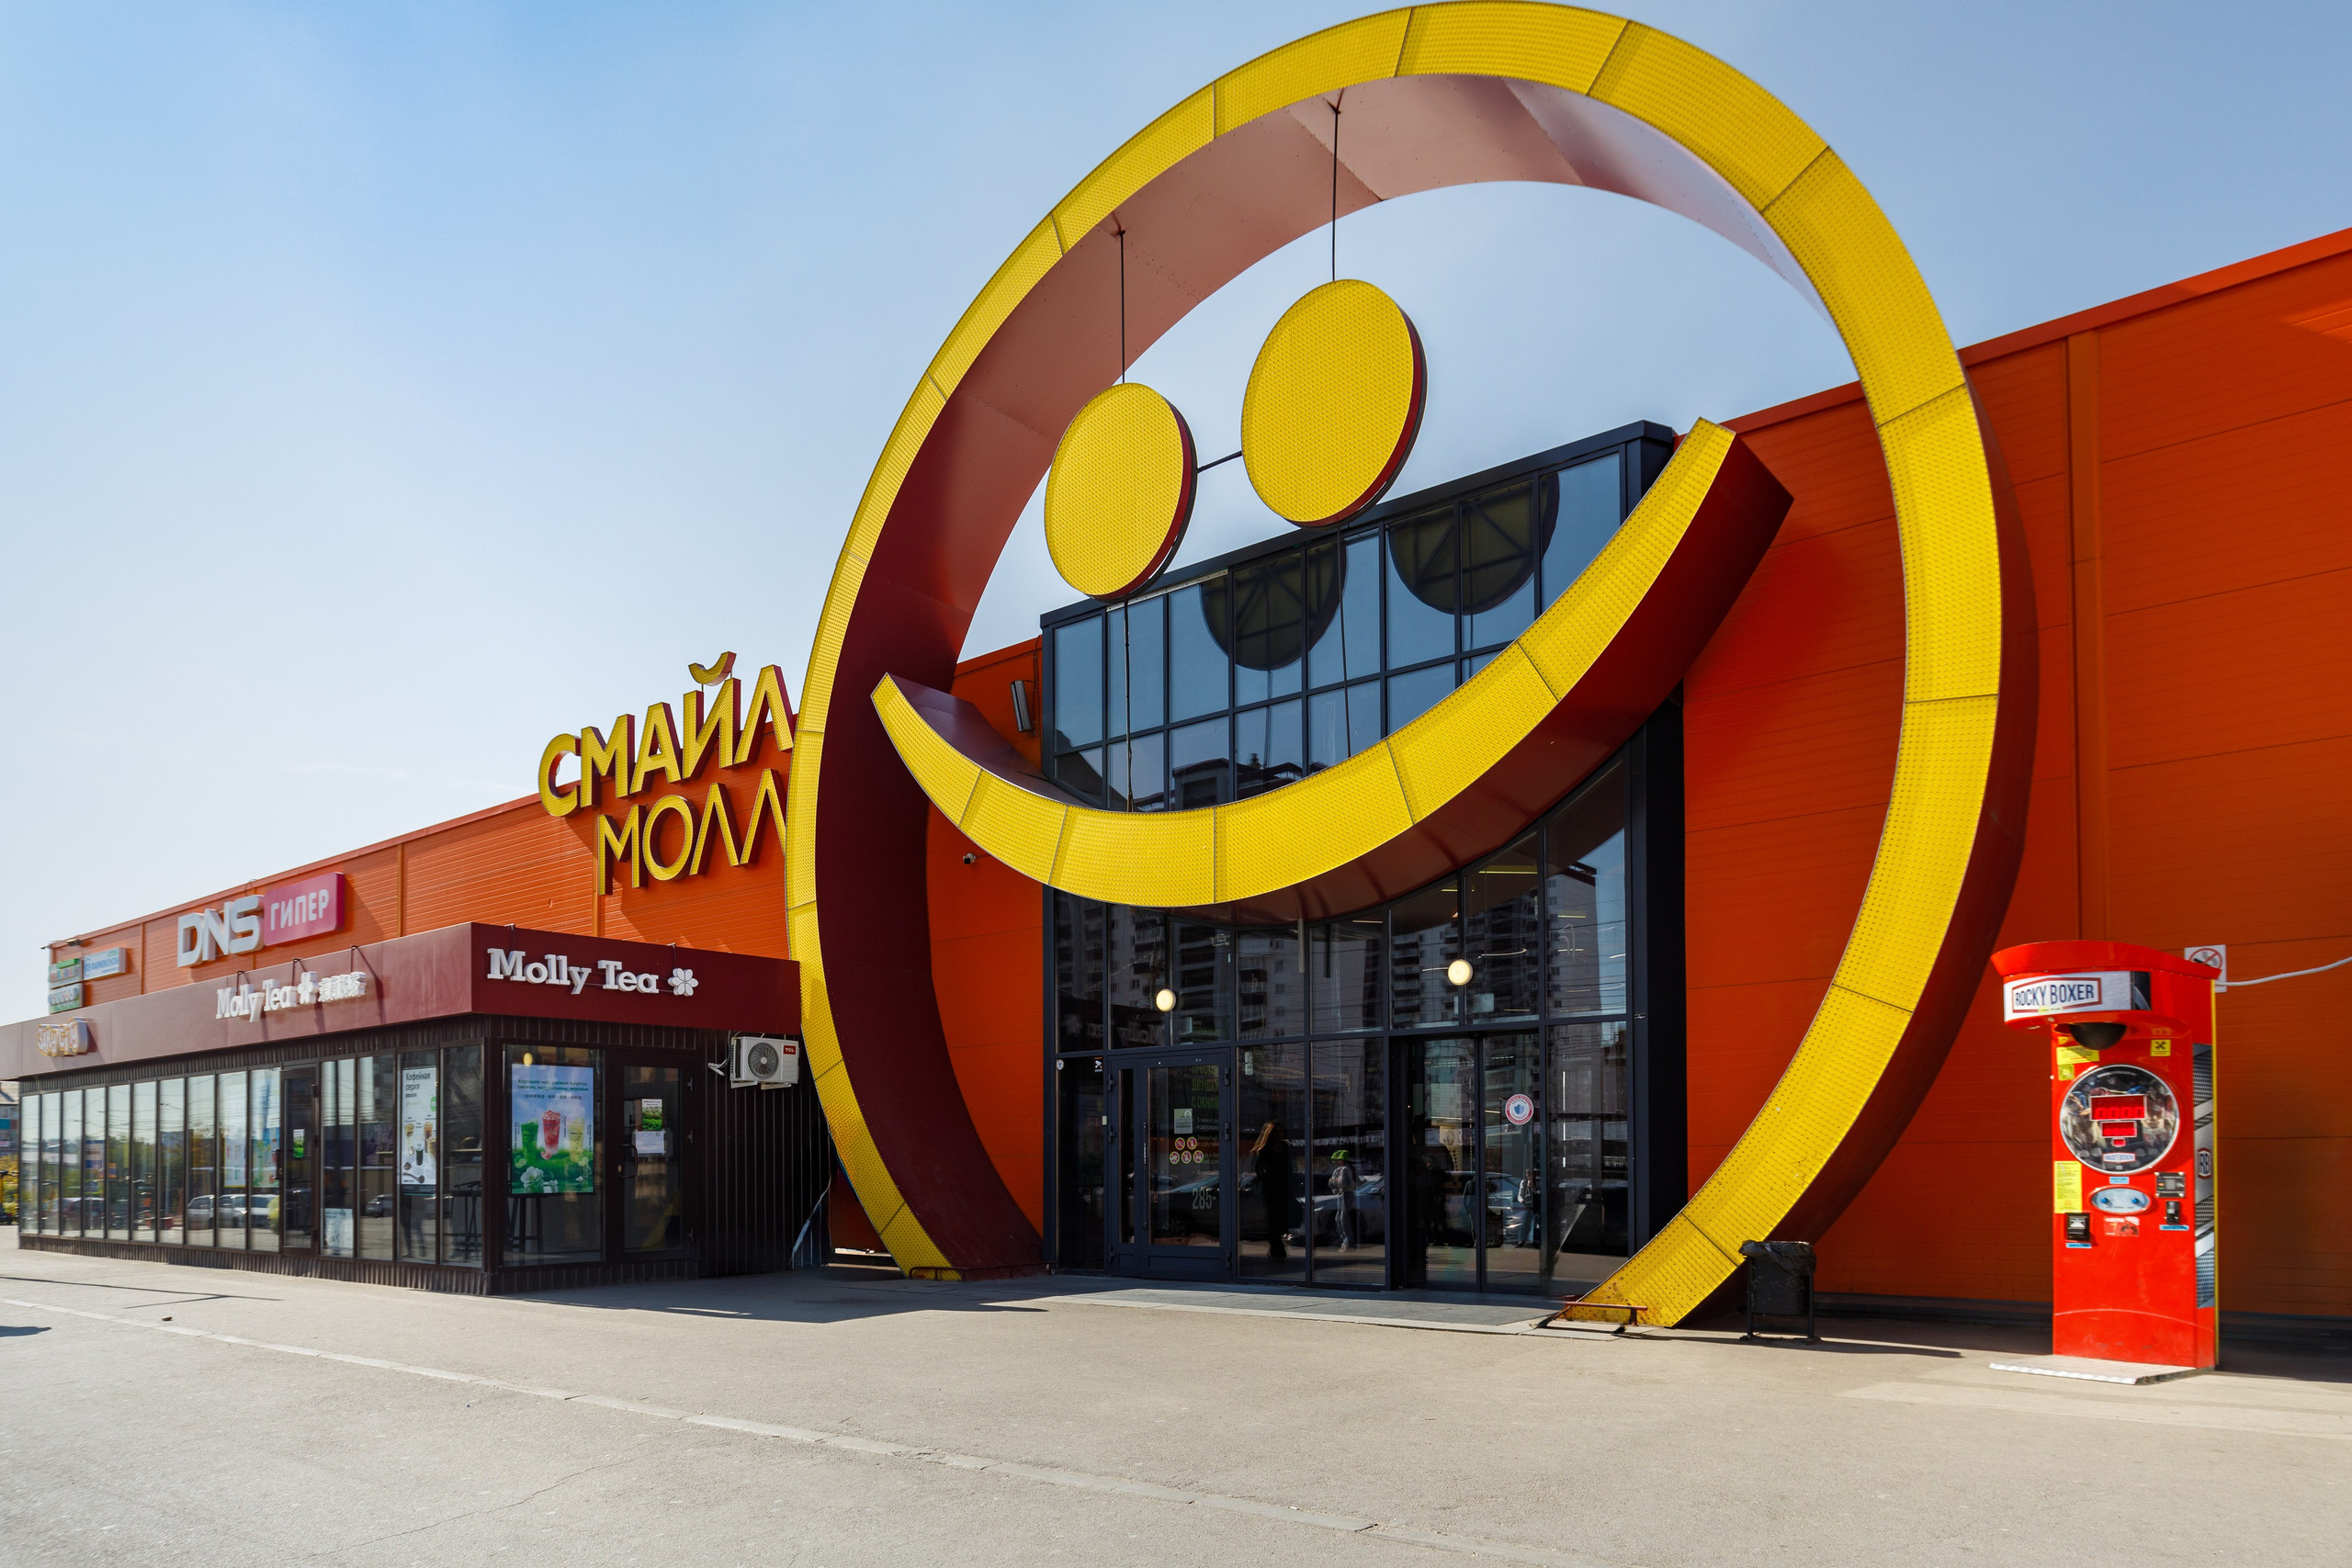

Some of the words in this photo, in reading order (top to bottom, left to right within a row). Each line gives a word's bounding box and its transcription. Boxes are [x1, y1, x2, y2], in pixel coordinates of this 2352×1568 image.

[538, 651, 794, 817] СМАЙЛ
[598, 769, 786, 896] МОЛЛ
[177, 895, 265, 967] DNS
[270, 889, 329, 931] ГИПЕР
[487, 948, 592, 995] Molly
[598, 960, 659, 994] Tea
[216, 984, 265, 1022] Molly
[263, 978, 300, 1011] Tea
[2015, 985, 2047, 1006] ROCKY
[2050, 984, 2095, 1005] BOXER
[405, 1072, 431, 1082] Кофейная
[2199, 1152, 2211, 1175] RB
